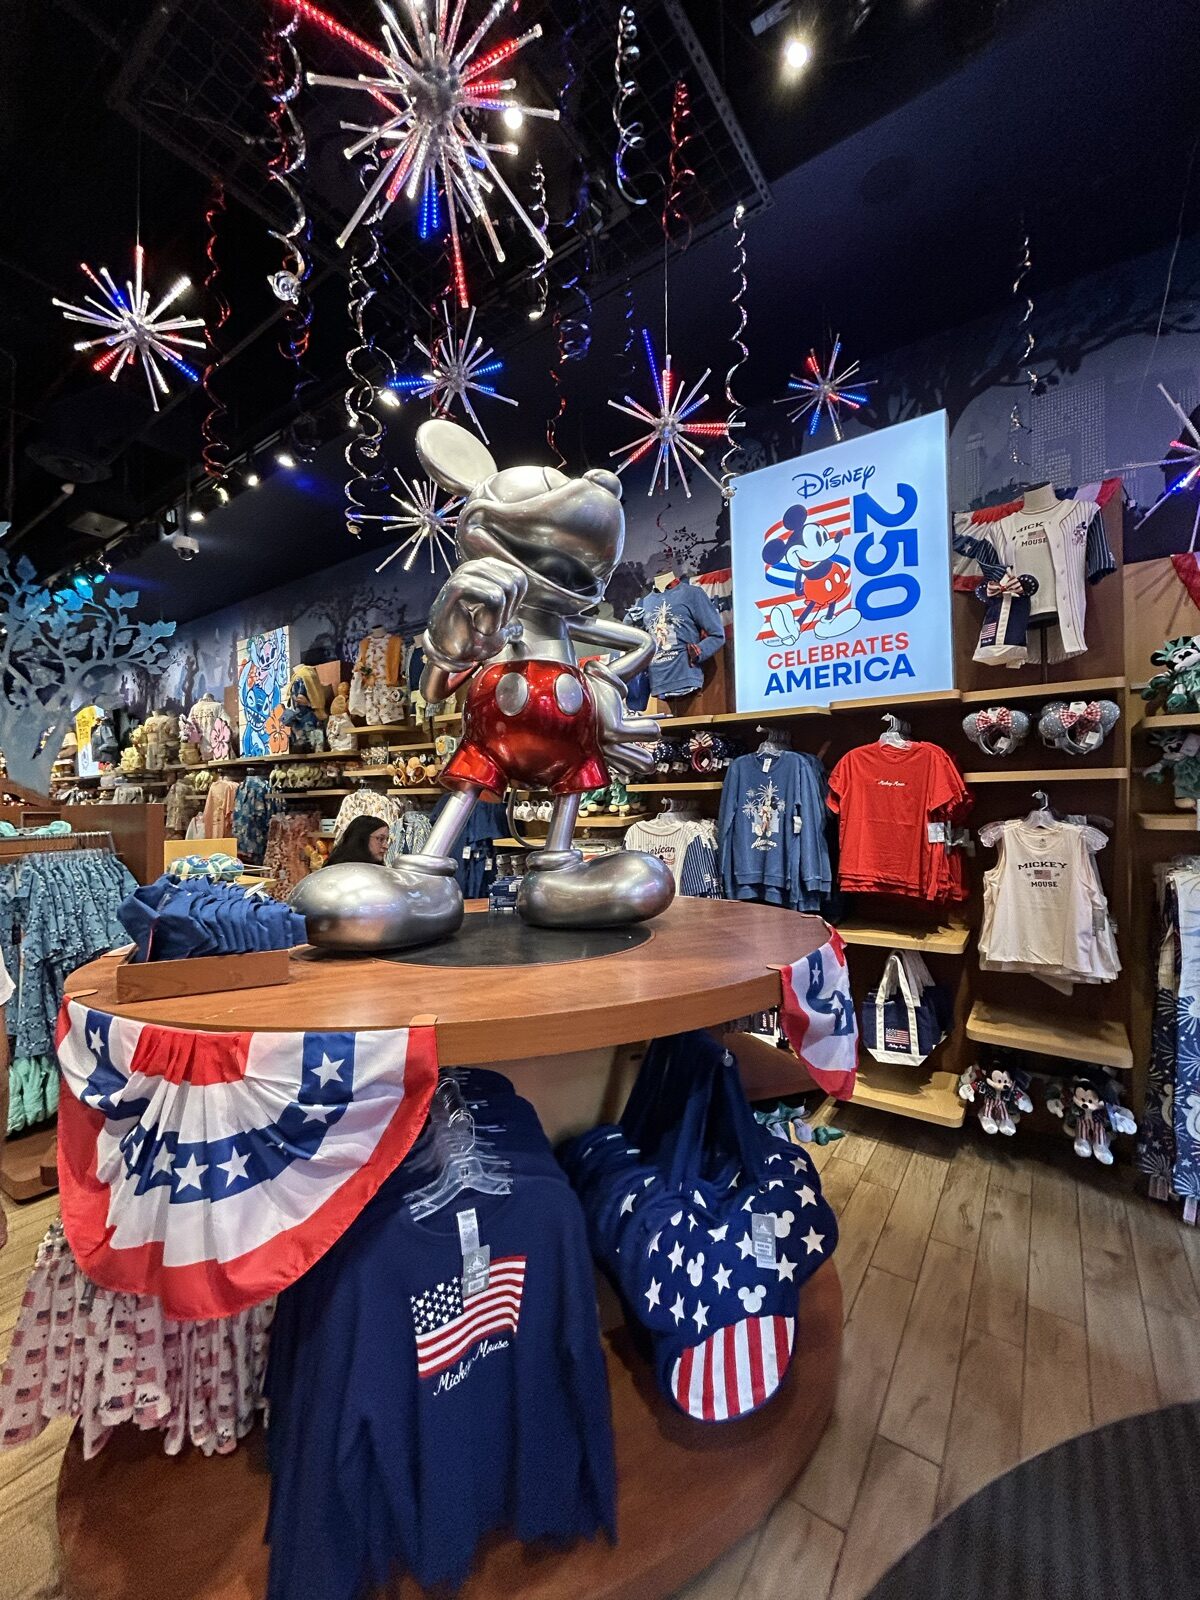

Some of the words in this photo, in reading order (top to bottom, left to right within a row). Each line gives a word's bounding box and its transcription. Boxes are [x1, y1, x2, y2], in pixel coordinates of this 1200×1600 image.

[853, 483, 921, 621] 250
[767, 632, 910, 670] CELEBRATES
[764, 653, 916, 697] AMERICA
[1017, 861, 1068, 870] MICKEY
[433, 1361, 472, 1396] Mickey
[472, 1340, 510, 1358] Mouse
